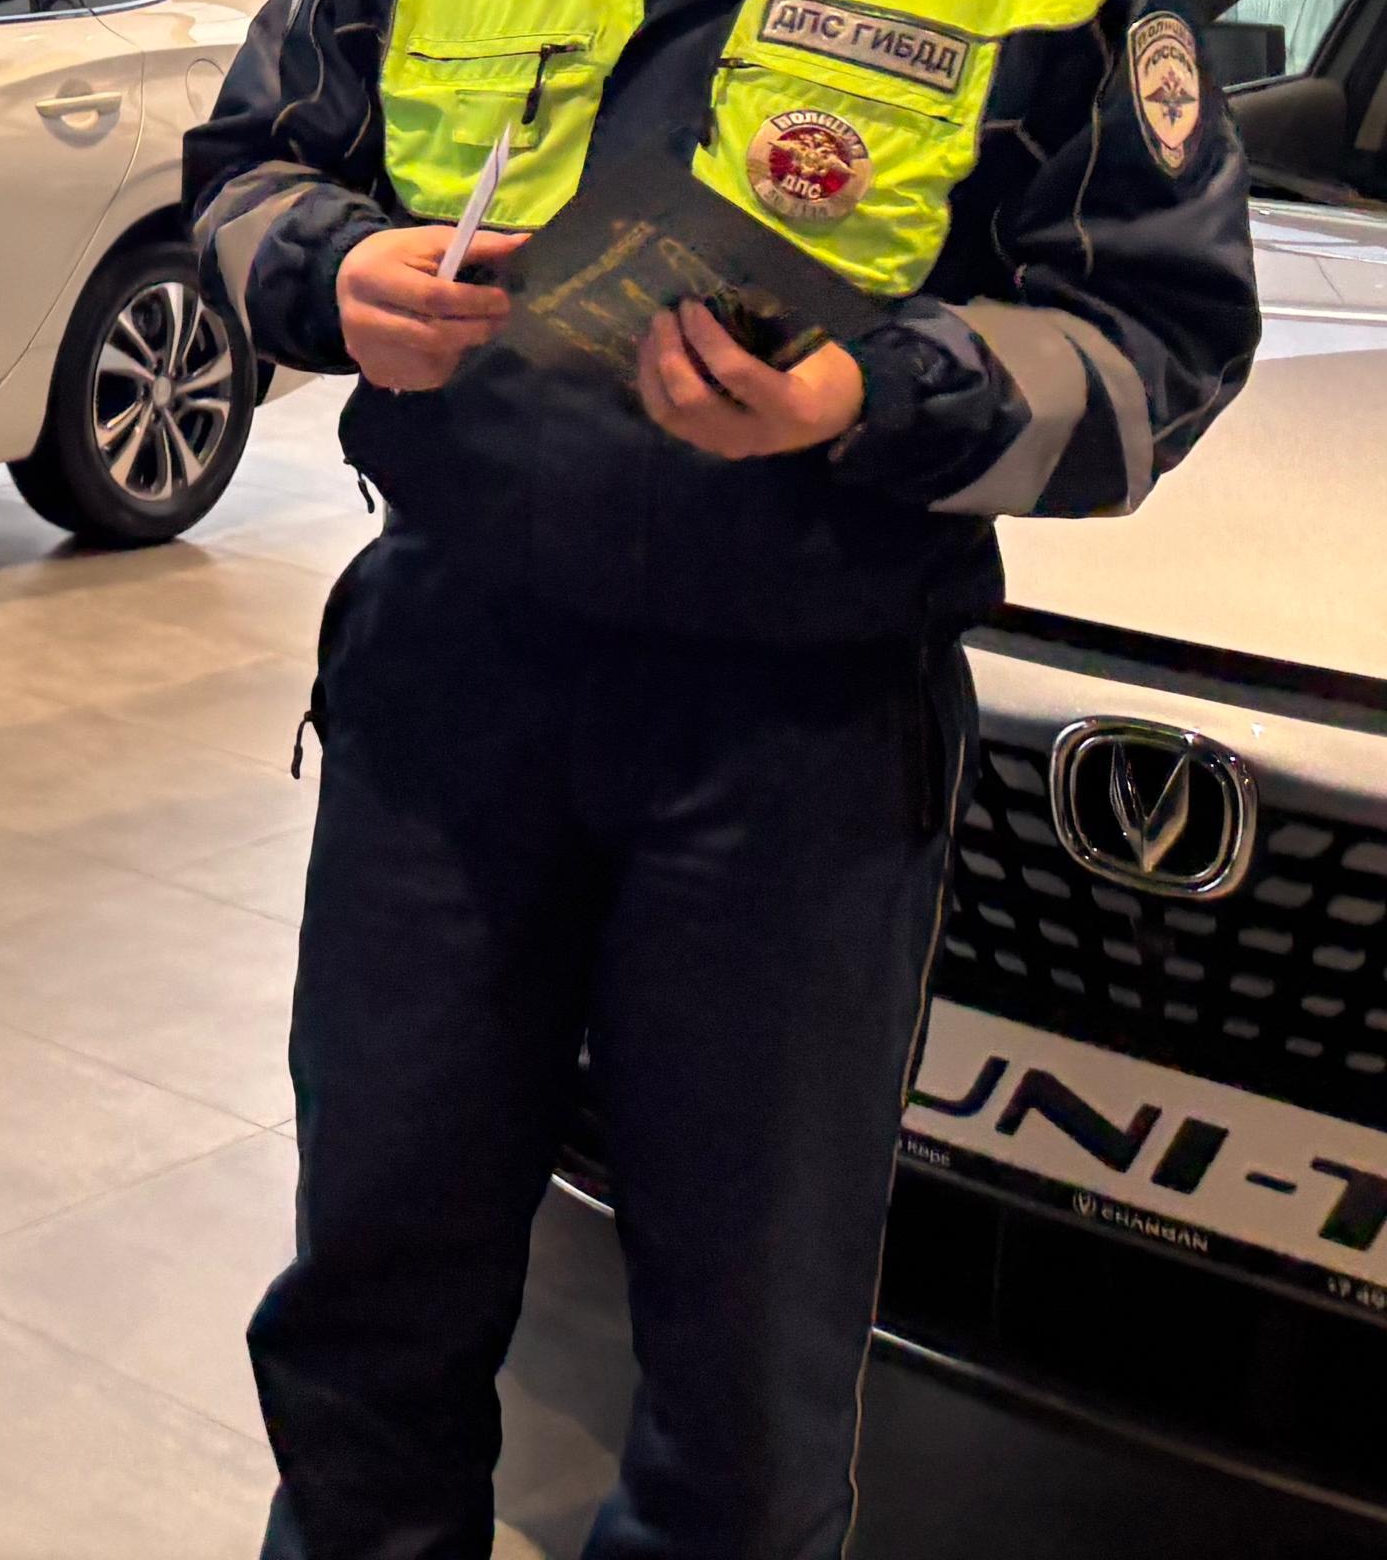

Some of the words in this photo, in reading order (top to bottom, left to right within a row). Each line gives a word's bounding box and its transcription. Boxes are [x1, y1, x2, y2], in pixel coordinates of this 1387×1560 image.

[773, 3, 845, 39] ДПС
[851, 23, 960, 79] ГИБДД
[781, 176, 823, 200] ДПС
[1100, 1206, 1209, 1253] CHANGAN
